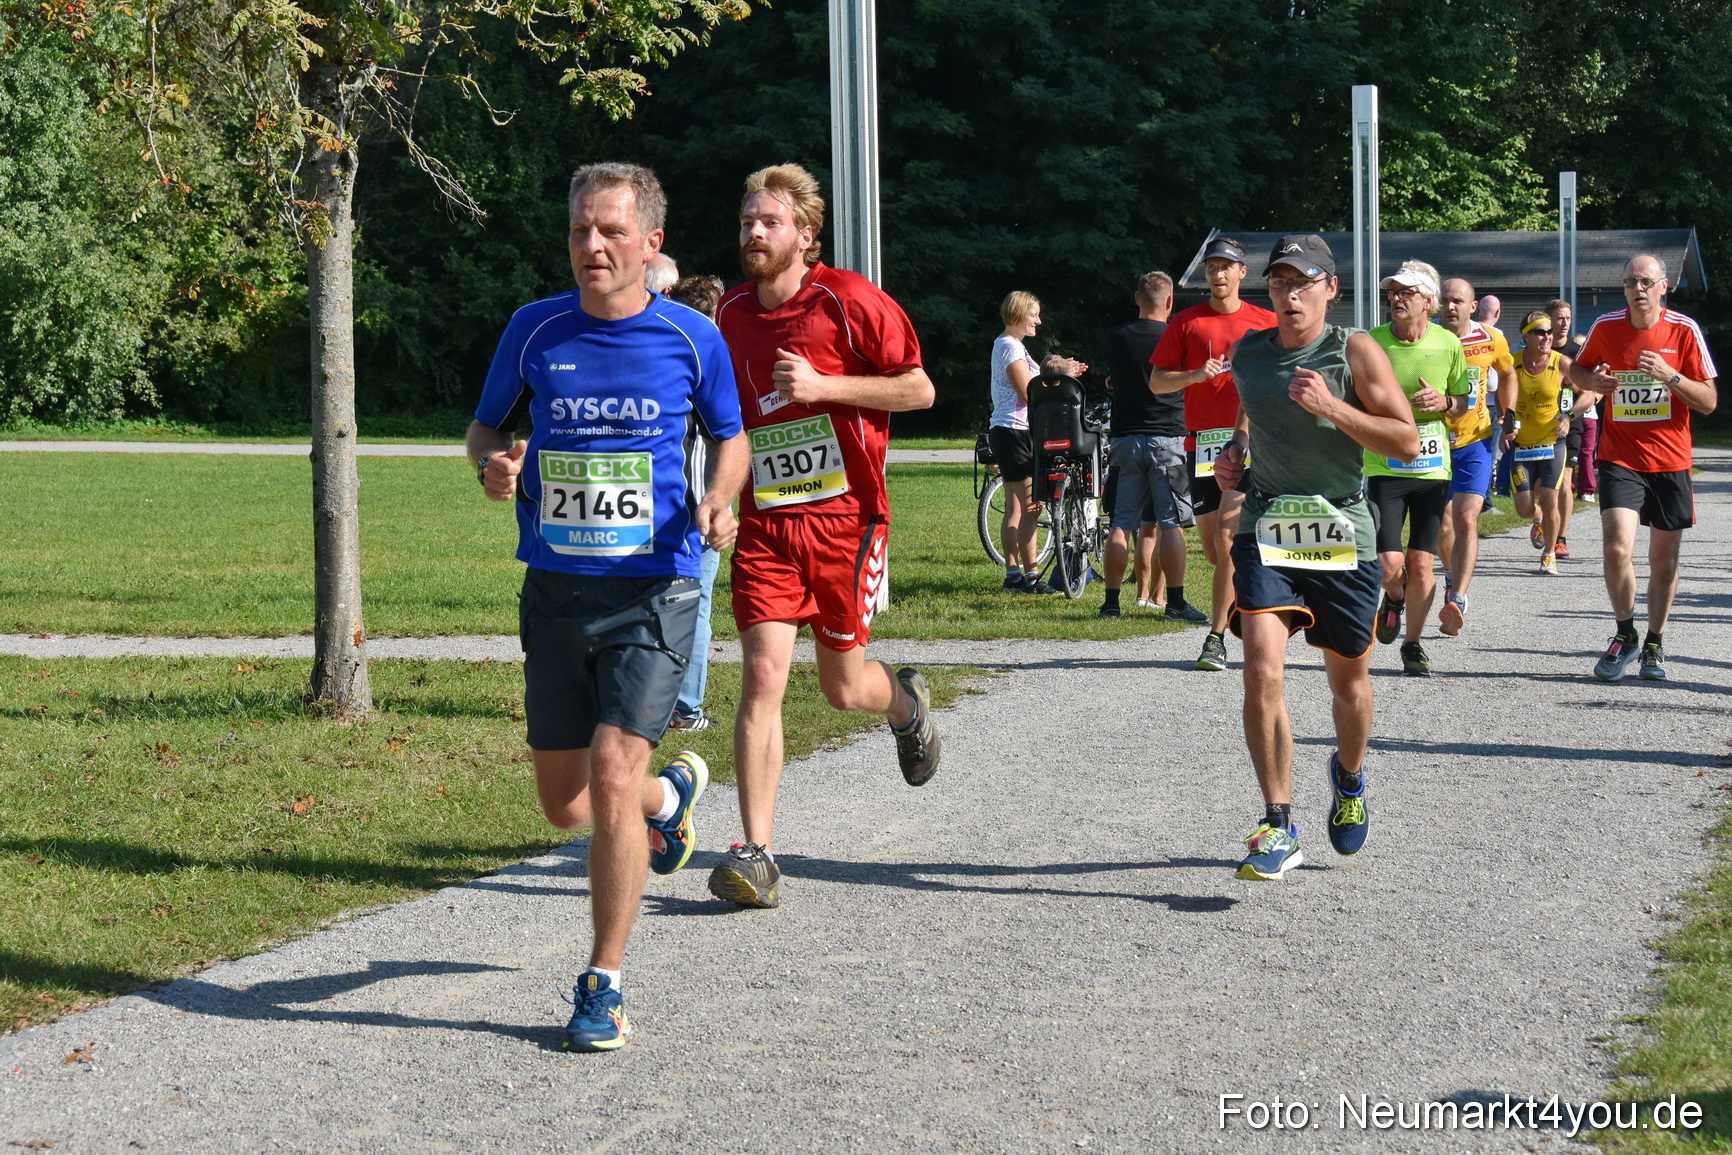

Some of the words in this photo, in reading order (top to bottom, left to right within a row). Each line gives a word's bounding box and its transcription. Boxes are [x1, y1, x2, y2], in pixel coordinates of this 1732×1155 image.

[1464, 345, 1494, 357] BÖGL
[1618, 388, 1663, 404] 1027
[550, 397, 661, 421] SYSCAD
[1624, 408, 1658, 416] ALFRED
[550, 425, 663, 437] www.metallbau-cad.de
[753, 419, 828, 451] BOCK
[546, 456, 642, 480] BOCK
[762, 444, 828, 480] 1307
[778, 479, 823, 496] SIMON
[552, 488, 639, 520] 2146
[569, 530, 619, 544] MARC
[1268, 522, 1344, 545] 1114
[1284, 551, 1332, 561] JONAS
[822, 625, 856, 641] hummel
